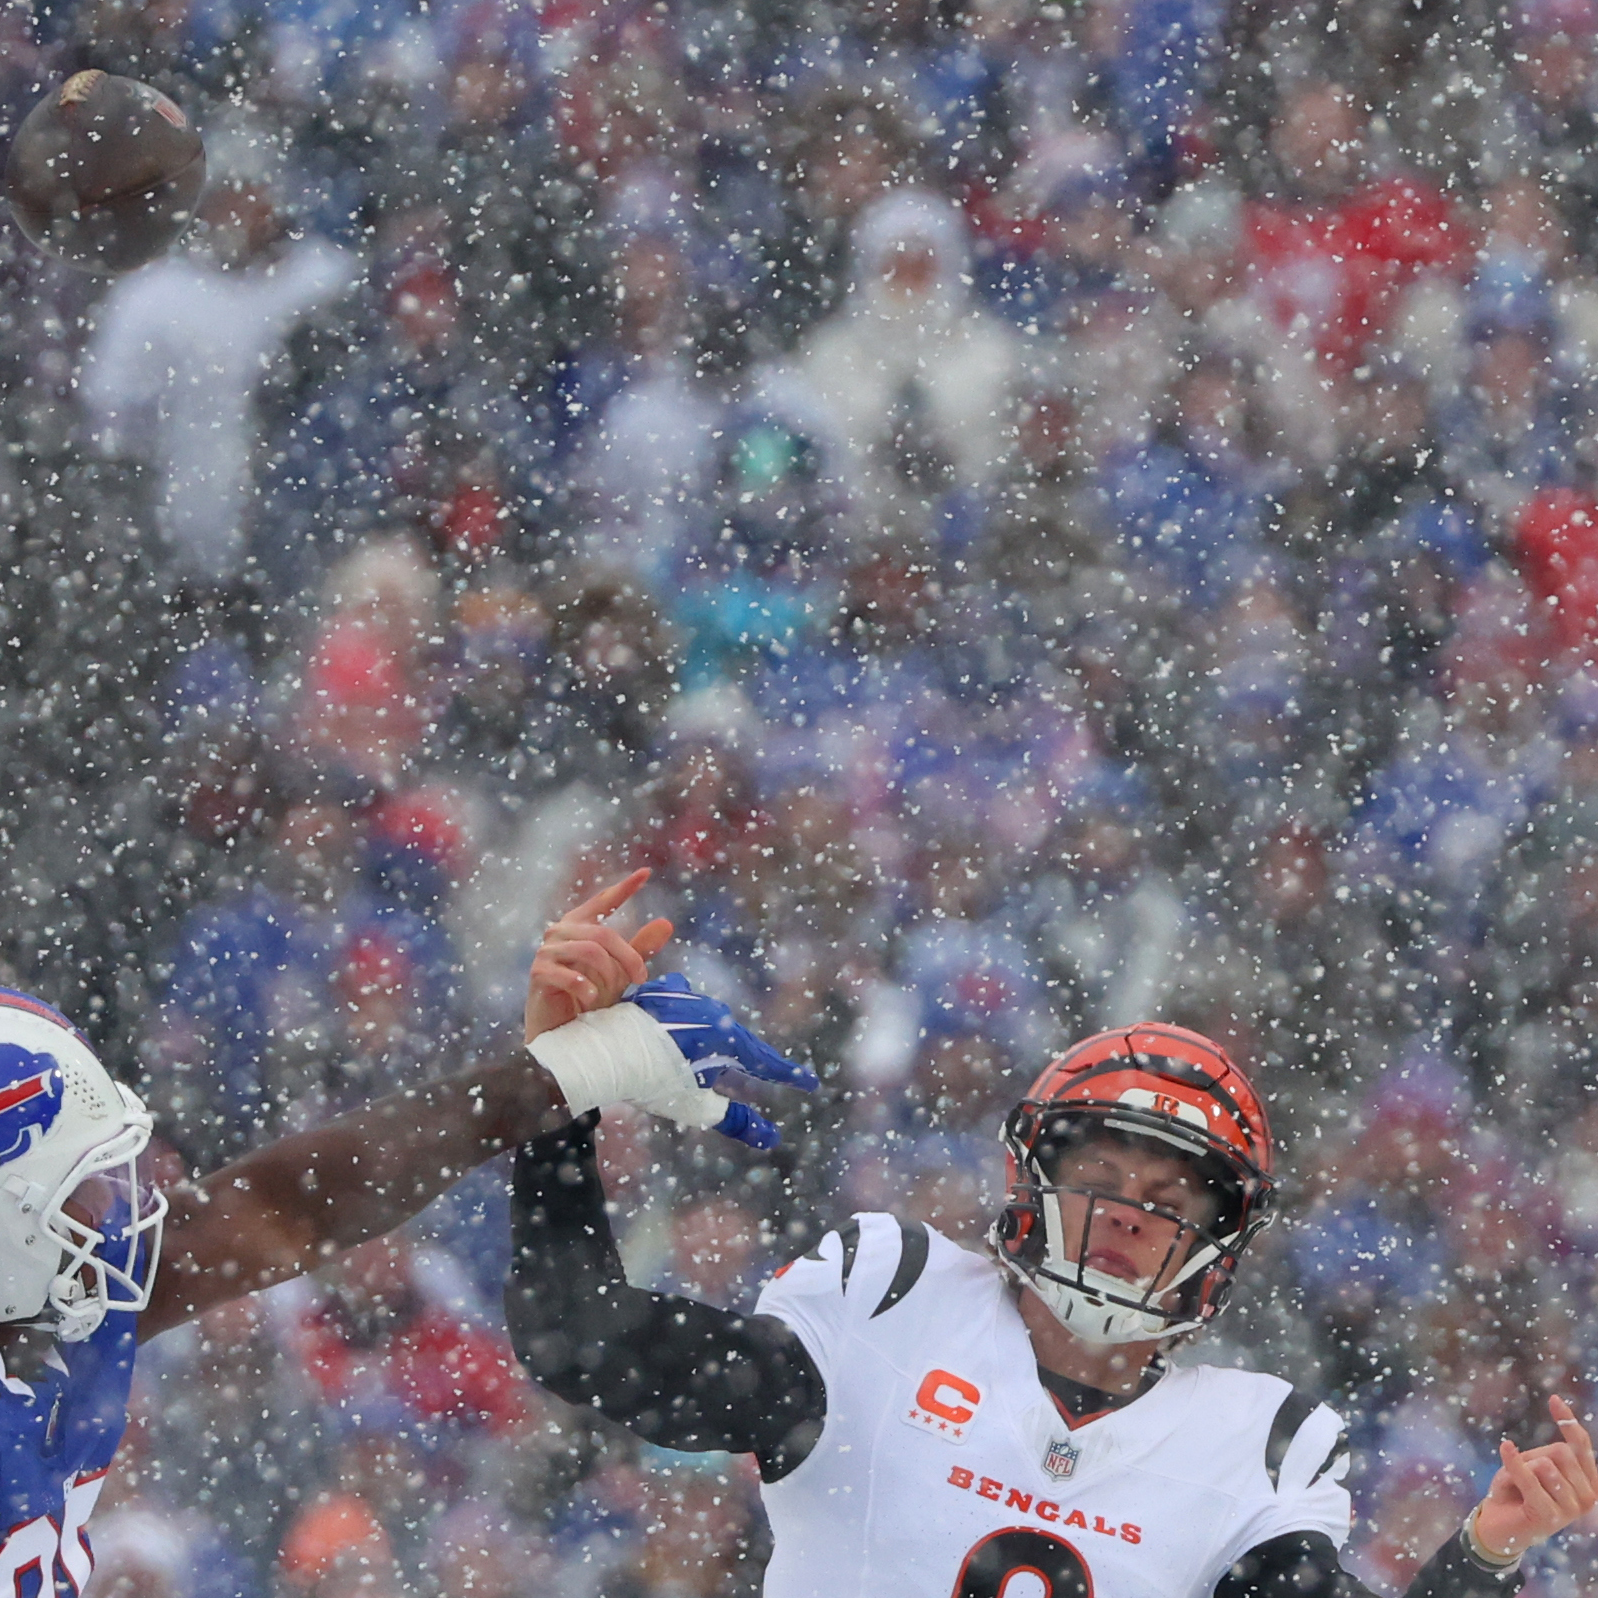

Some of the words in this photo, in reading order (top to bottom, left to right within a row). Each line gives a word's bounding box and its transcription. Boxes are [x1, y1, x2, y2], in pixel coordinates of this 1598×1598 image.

[916, 1369, 981, 1424] C
[1046, 1453, 1073, 1476] NFL
[947, 1466, 1142, 1545] BENGALS
